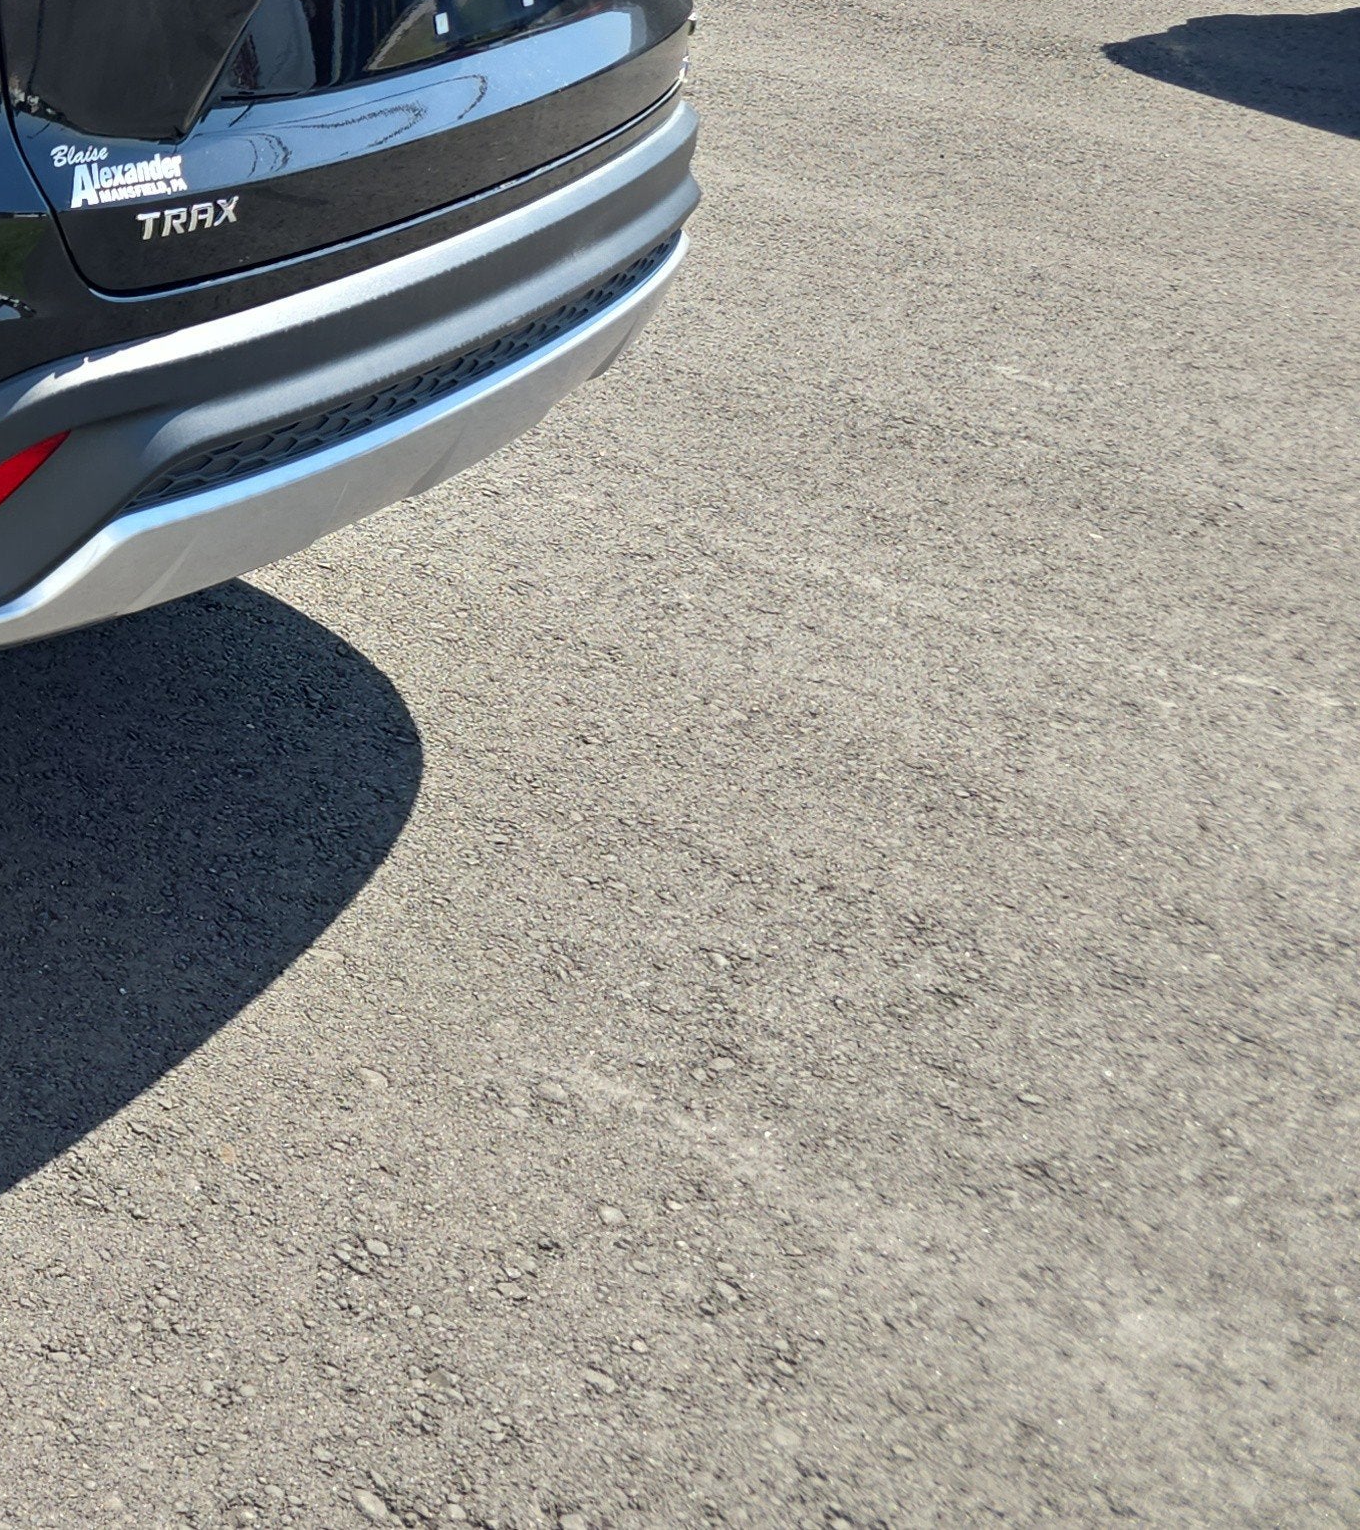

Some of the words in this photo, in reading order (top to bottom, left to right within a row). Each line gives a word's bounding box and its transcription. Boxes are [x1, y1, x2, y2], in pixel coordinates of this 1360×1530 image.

[49, 144, 109, 168] Blaise
[70, 153, 182, 209] Alexander
[98, 180, 172, 204] MANSFIELD,
[171, 177, 188, 194] PA
[135, 195, 240, 241] TRAX
